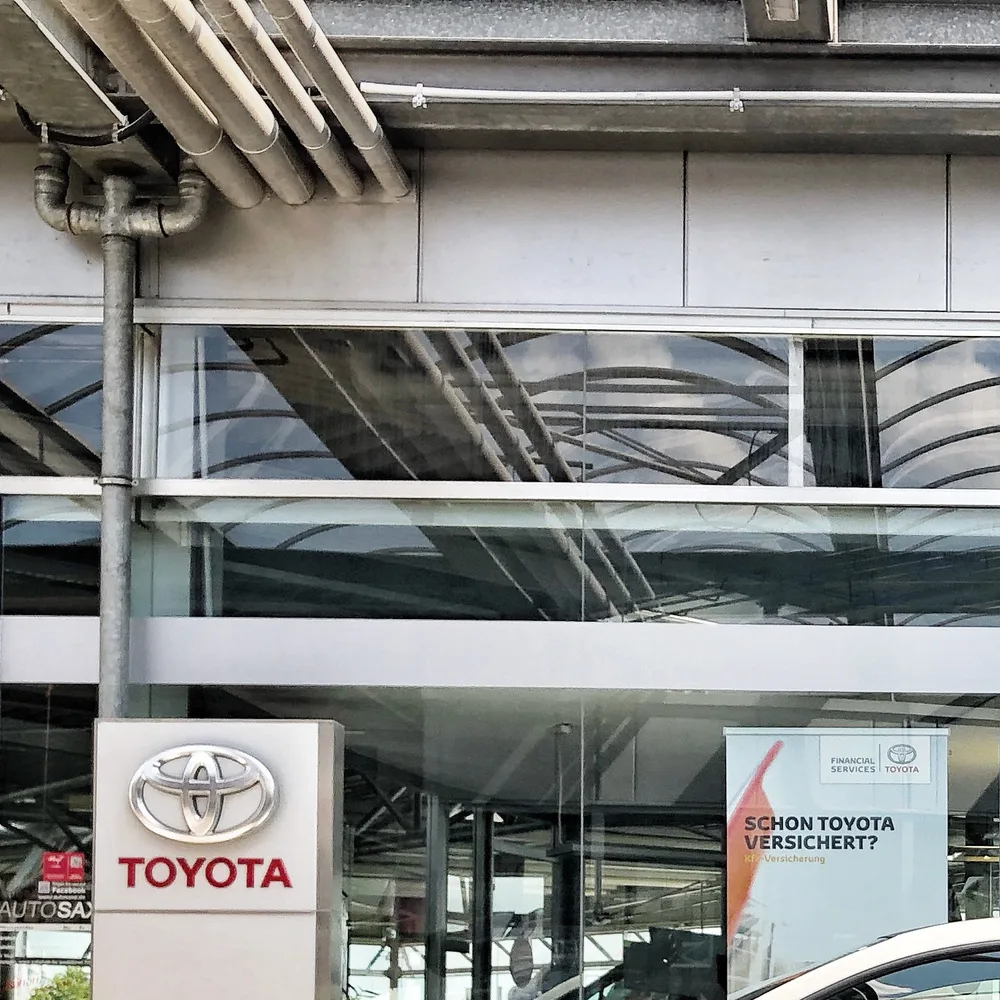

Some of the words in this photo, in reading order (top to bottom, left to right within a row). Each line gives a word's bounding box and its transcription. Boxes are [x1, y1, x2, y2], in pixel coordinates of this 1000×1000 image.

[744, 816, 813, 831] SCHON
[817, 816, 895, 831] TOYOTA
[744, 835, 878, 850] VERSICHERT?
[118, 856, 293, 888] TOYOTA
